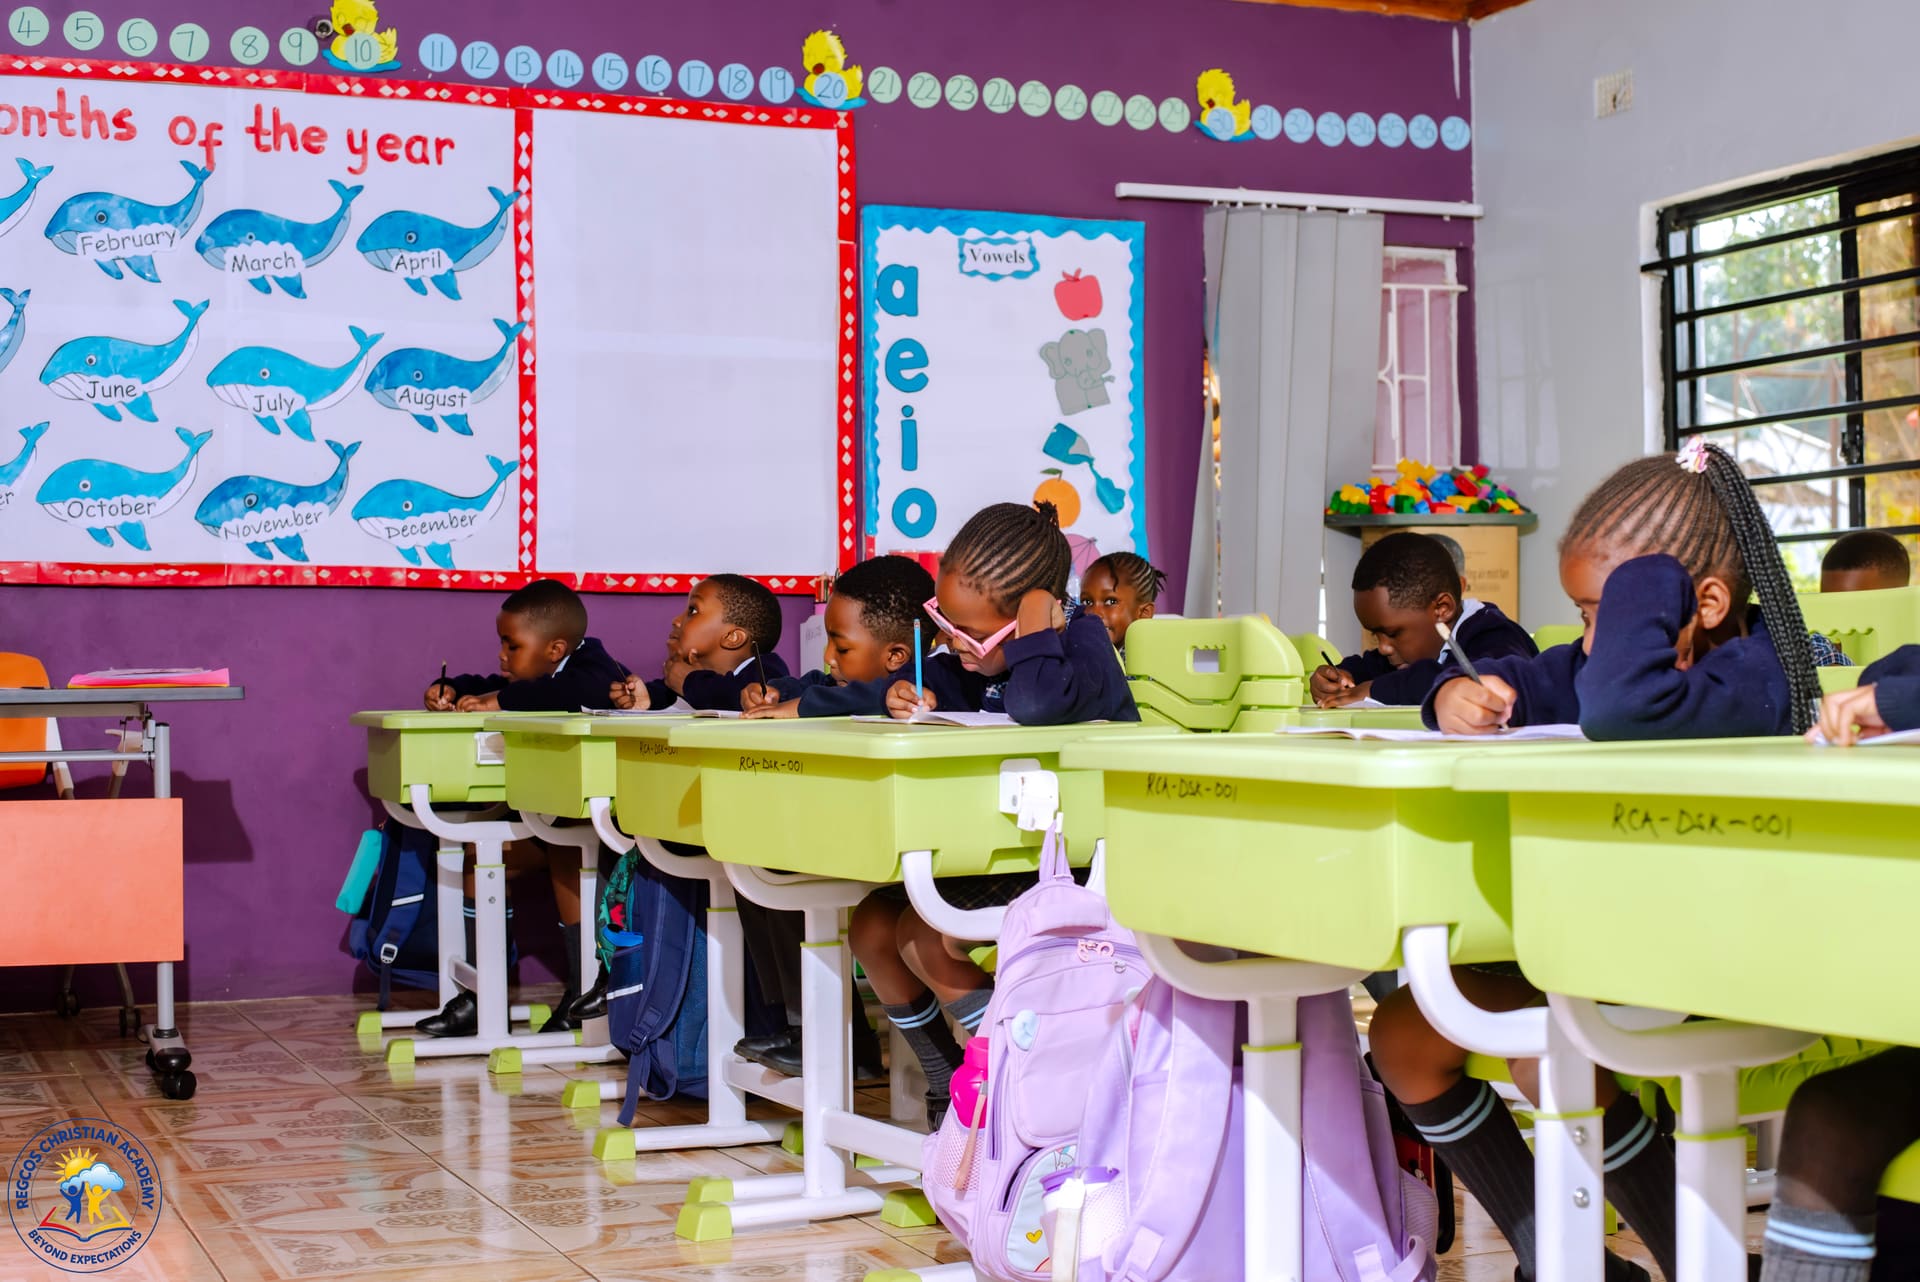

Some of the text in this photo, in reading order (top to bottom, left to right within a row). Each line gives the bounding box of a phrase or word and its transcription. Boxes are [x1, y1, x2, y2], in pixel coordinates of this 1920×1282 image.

[17, 12, 40, 38] 4
[75, 18, 94, 43] 5
[126, 22, 147, 51] 6
[176, 31, 196, 57] 7
[242, 35, 258, 57] 8
[288, 32, 302, 62] 9
[353, 39, 371, 62] 10
[431, 40, 444, 68] 11
[470, 46, 491, 71] 12
[516, 51, 532, 76] 13
[557, 55, 580, 82] 14
[602, 59, 623, 84] 15
[644, 60, 665, 85] 16
[686, 66, 705, 92] 17
[727, 67, 747, 94] 18
[769, 69, 787, 98] 19
[817, 74, 844, 99] 20
[872, 70, 894, 95] 21
[912, 75, 937, 100] 22
[950, 78, 976, 104] 23
[987, 81, 1013, 109] 24
[1060, 87, 1085, 115] 26
[1129, 99, 1150, 124] 28
[1163, 101, 1185, 124] 29
[1255, 107, 1274, 132] 31
[1412, 120, 1434, 141] 36
[168, 114, 223, 172] of
[245, 104, 328, 155] the
[347, 128, 455, 175] year
[80, 230, 177, 255] February
[969, 248, 1026, 265] Vowels
[231, 252, 297, 273] March
[395, 251, 442, 274] April
[876, 263, 919, 317] a
[885, 338, 929, 393] e
[86, 380, 137, 399] June
[399, 388, 468, 410] August
[252, 393, 296, 417] July
[901, 405, 918, 471] i
[67, 498, 157, 518] October
[892, 488, 937, 538] o
[223, 509, 324, 541] November
[385, 512, 477, 540] December
[739, 757, 803, 775] RCA-DSK-001
[1147, 773, 1237, 802] RCA-DSK-001
[1613, 802, 1792, 840] RCA-DSK-001
